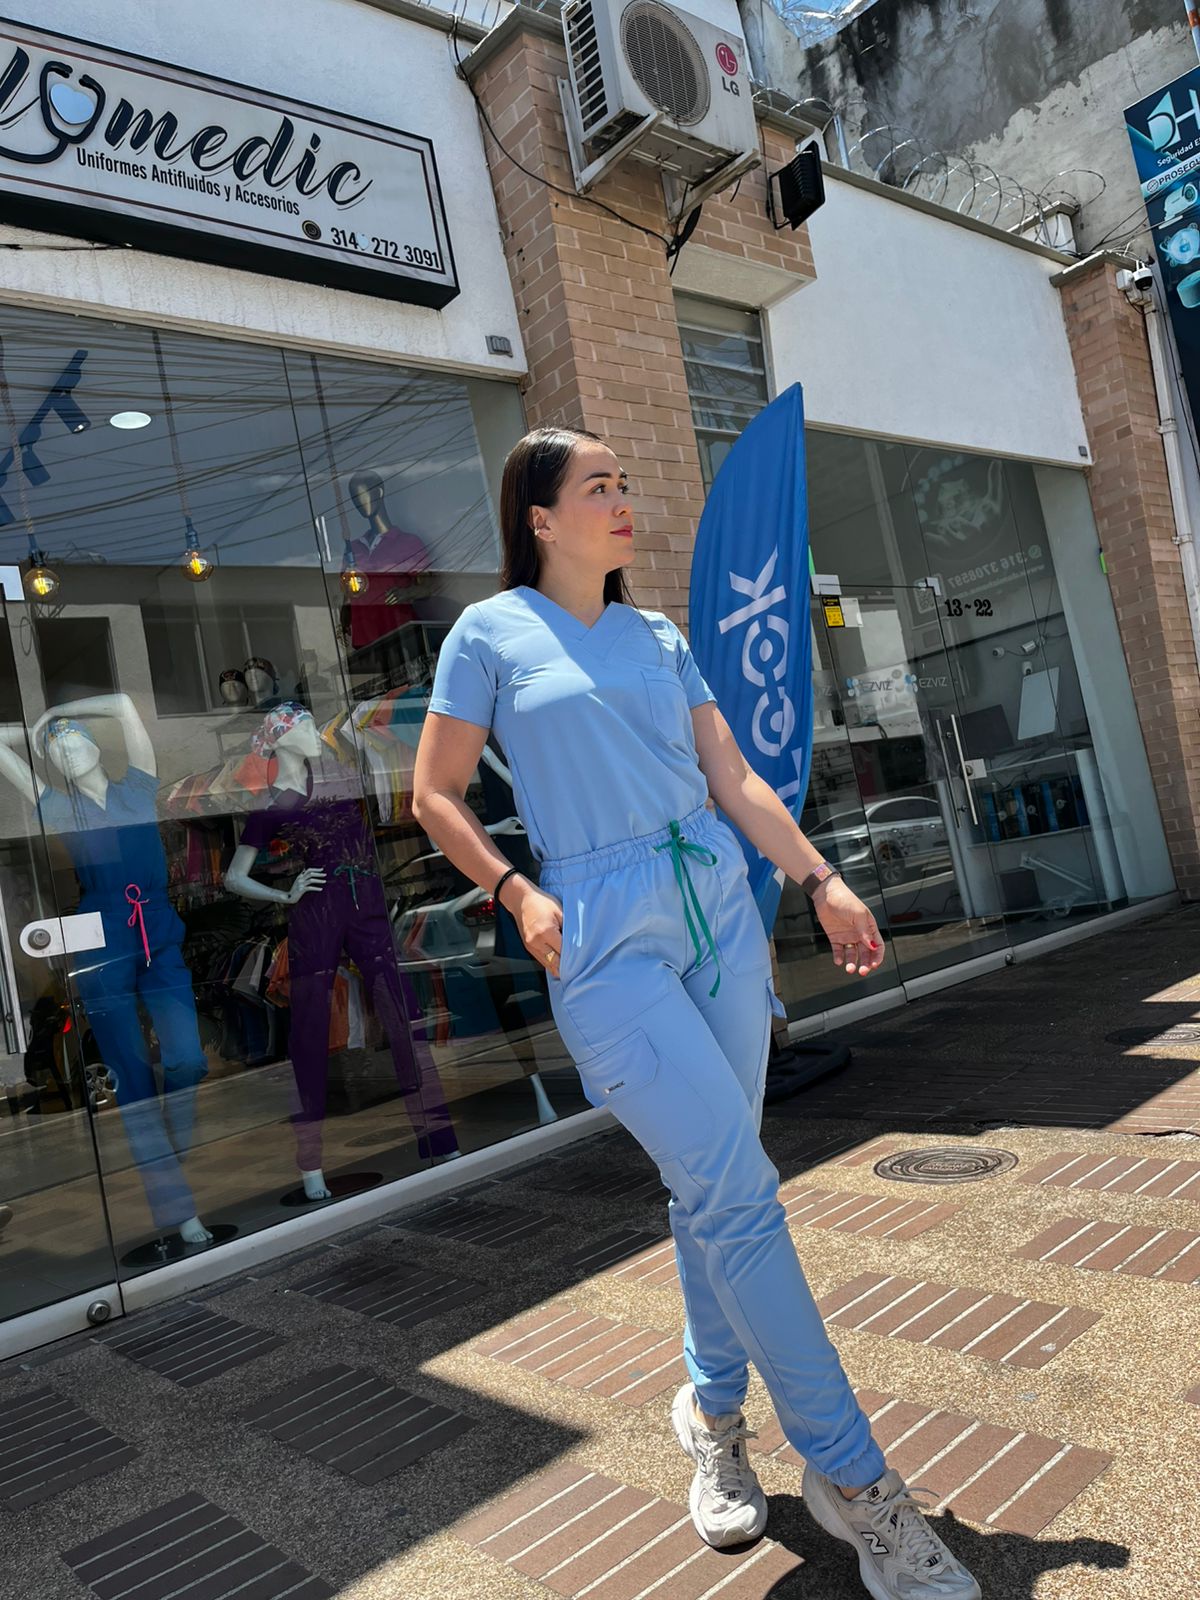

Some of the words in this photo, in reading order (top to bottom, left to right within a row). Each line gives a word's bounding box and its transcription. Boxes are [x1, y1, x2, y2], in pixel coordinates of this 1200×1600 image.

[721, 76, 740, 97] LG
[1157, 142, 1194, 168] Seguridad
[76, 147, 148, 180] Uniformes
[151, 164, 221, 197] Antifluidos
[223, 184, 232, 201] y
[235, 184, 300, 216] Accesorios
[330, 227, 358, 249] 314
[371, 237, 400, 259] 272
[404, 245, 439, 268] 3091
[918, 676, 948, 689] EZVIZ
